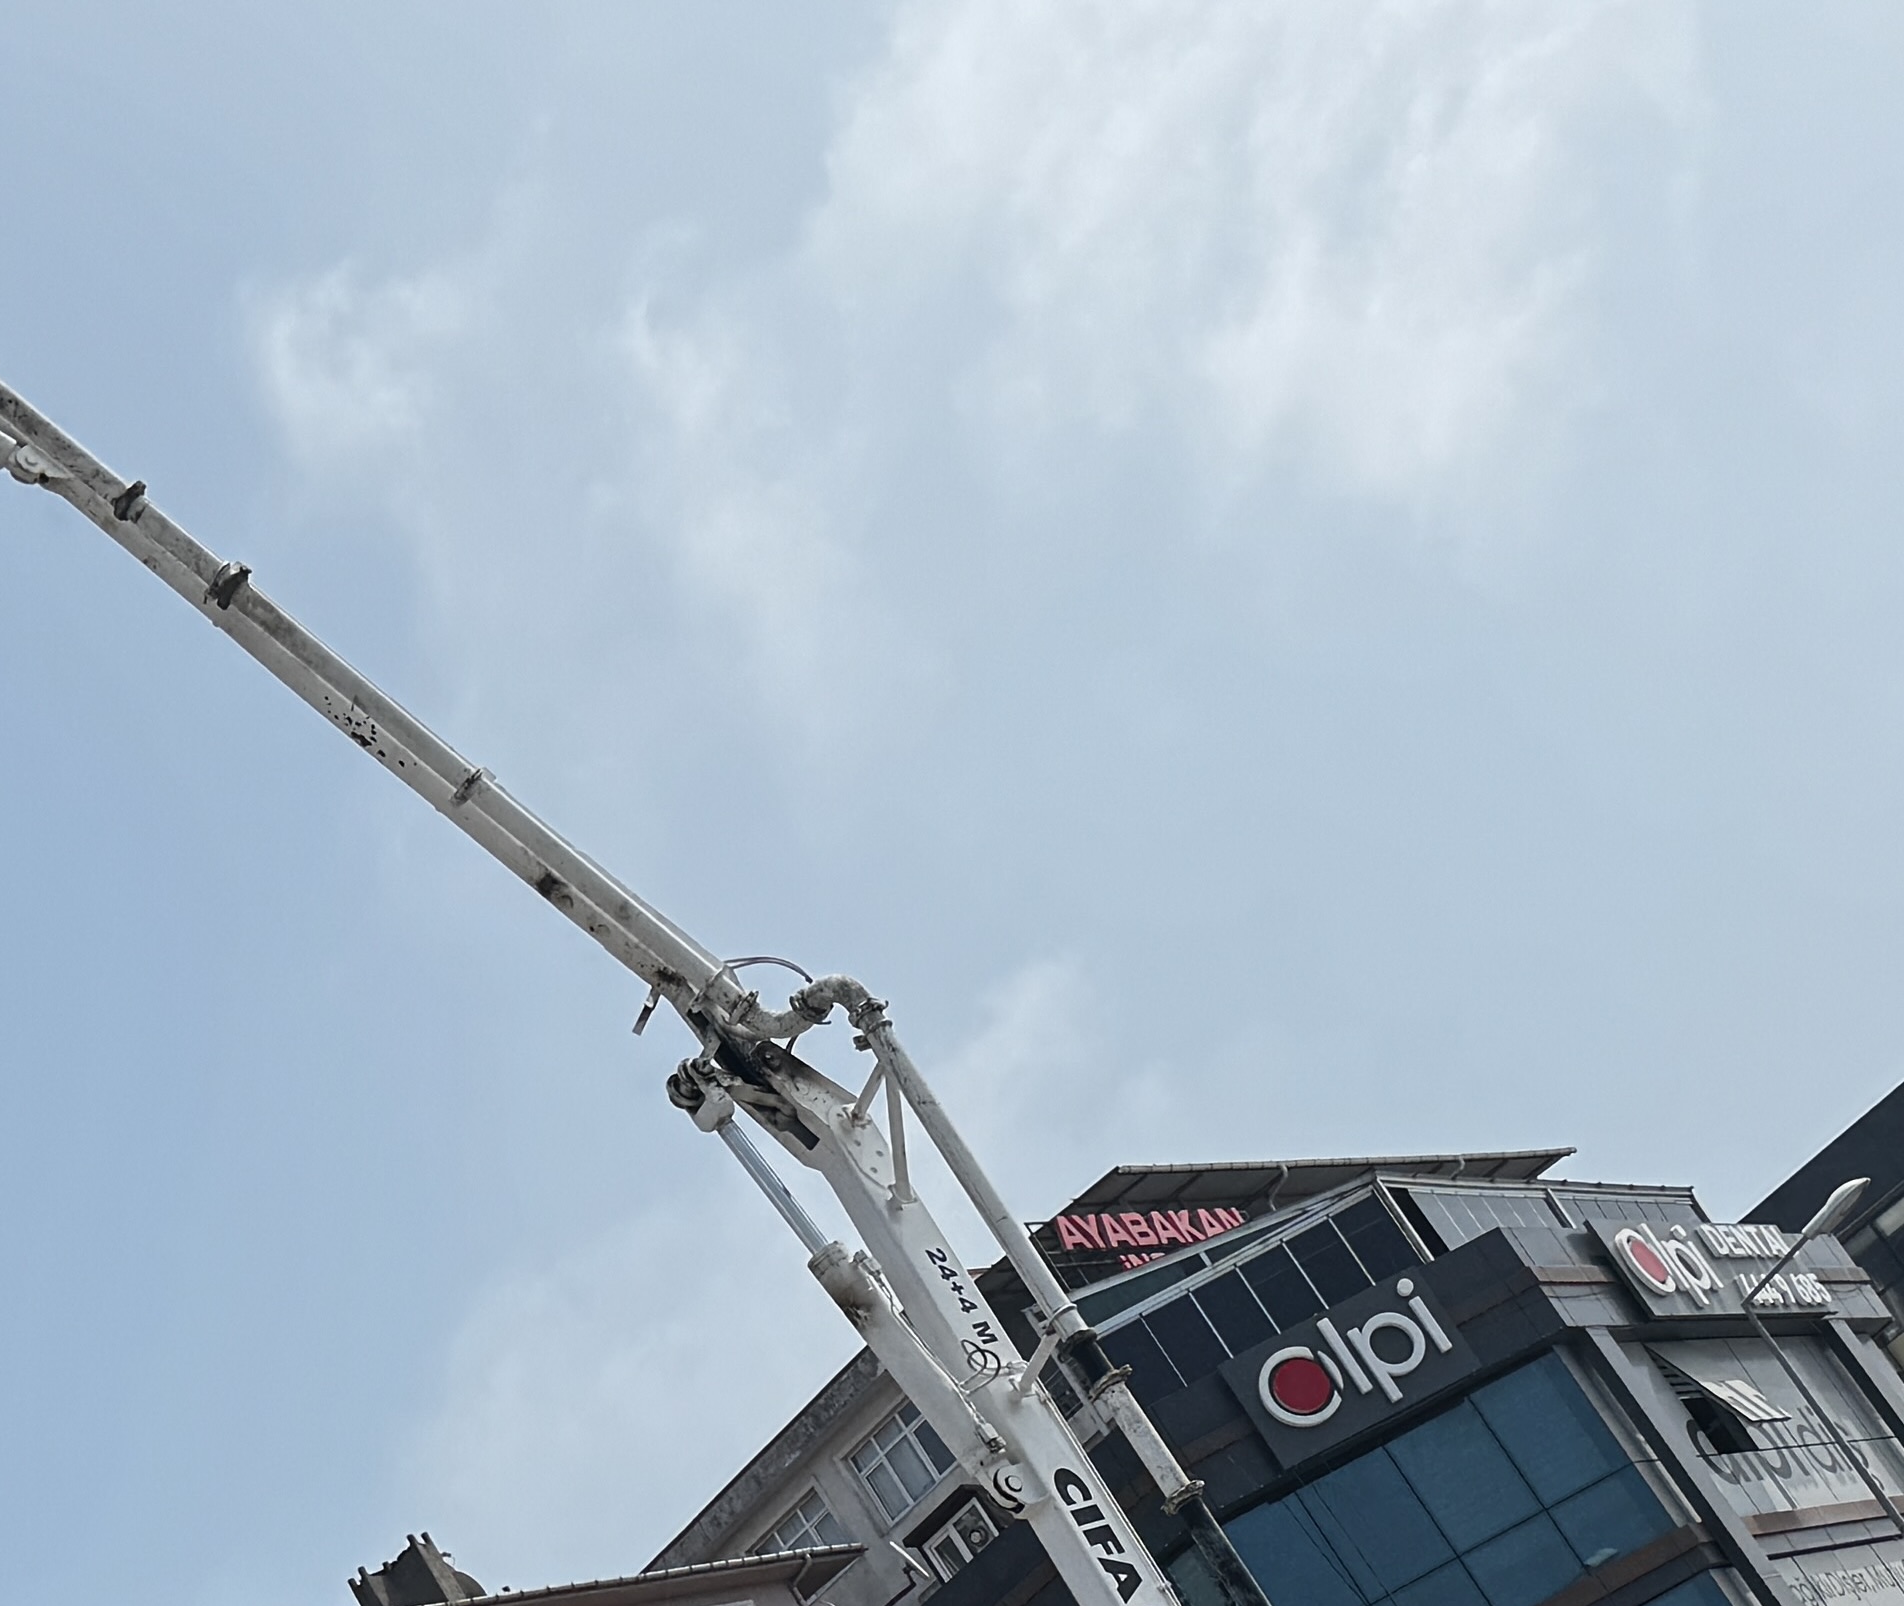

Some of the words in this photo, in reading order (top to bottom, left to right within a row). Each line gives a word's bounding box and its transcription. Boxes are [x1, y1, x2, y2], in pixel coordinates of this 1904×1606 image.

[1056, 1207, 1246, 1250] AYABAKAN
[1615, 1223, 1724, 1305] alpi
[1700, 1224, 1791, 1258] DENTAL
[925, 1247, 978, 1314] 24+4
[972, 1321, 998, 1345] M
[1258, 1278, 1453, 1427] alpi
[1054, 1468, 1143, 1604] CIFA
